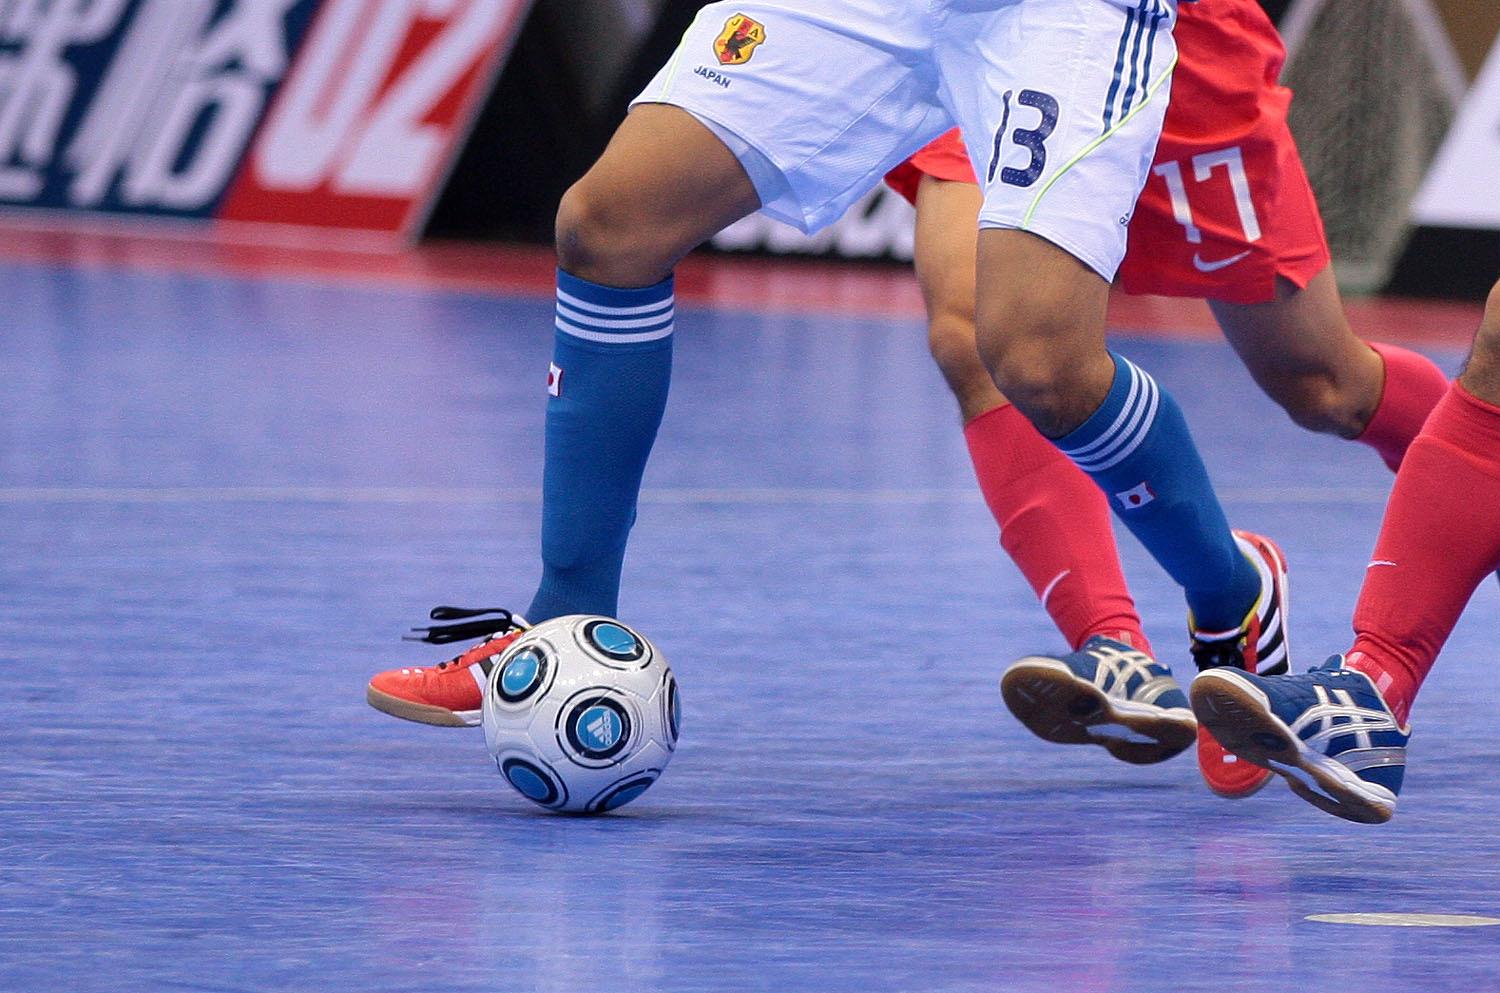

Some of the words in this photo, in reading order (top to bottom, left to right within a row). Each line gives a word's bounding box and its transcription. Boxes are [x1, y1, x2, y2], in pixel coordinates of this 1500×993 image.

[693, 65, 731, 88] JAPAN
[988, 89, 1059, 188] 13
[1153, 145, 1263, 244] 17
